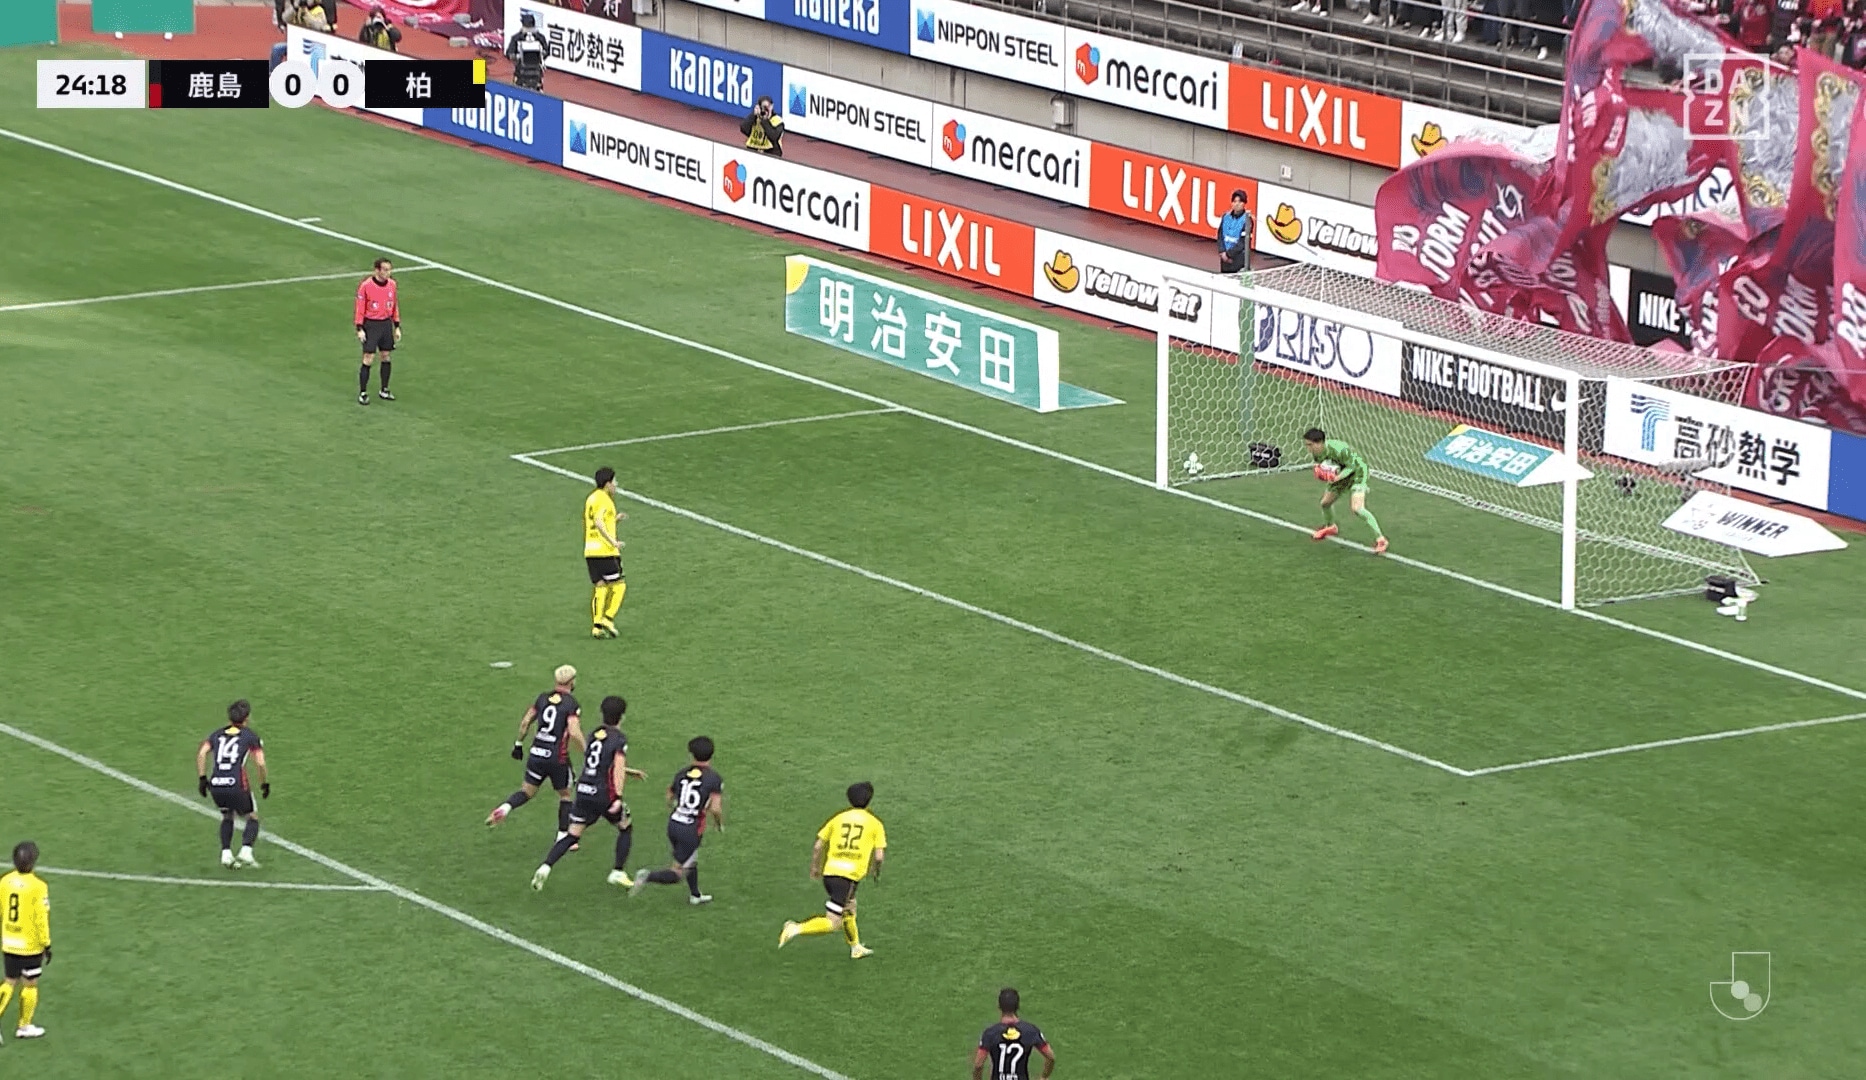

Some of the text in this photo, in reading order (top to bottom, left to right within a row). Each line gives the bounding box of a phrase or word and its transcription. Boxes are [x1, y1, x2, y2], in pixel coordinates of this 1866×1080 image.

[548, 24, 625, 74] 高砂熱学
[938, 18, 1059, 67] NIPPON STEEL
[1106, 56, 1218, 111] mercari
[809, 95, 927, 144] NIPPON STEEL
[1261, 80, 1367, 151] LIXIL
[589, 131, 707, 183] NIPPON STEEL
[971, 135, 1081, 189] mercari
[752, 177, 860, 232] mercari
[1121, 159, 1222, 229] LIXIL
[902, 203, 1001, 277] LIXIL
[1085, 264, 1202, 323] Yellow at
[1638, 291, 1681, 333] NIKE
[818, 276, 1016, 394] 明治安田
[1411, 346, 1545, 413] NIKE FOOTBALL
[1445, 434, 1539, 476] 明治安田
[1673, 414, 1802, 487] 高砂熱学
[1716, 510, 1790, 539] WINNER
[542, 704, 557, 732] 9
[216, 735, 240, 764] 14
[587, 740, 603, 768] 3
[678, 778, 702, 809] 16
[837, 822, 864, 850] 32
[8, 892, 19, 922] 8
